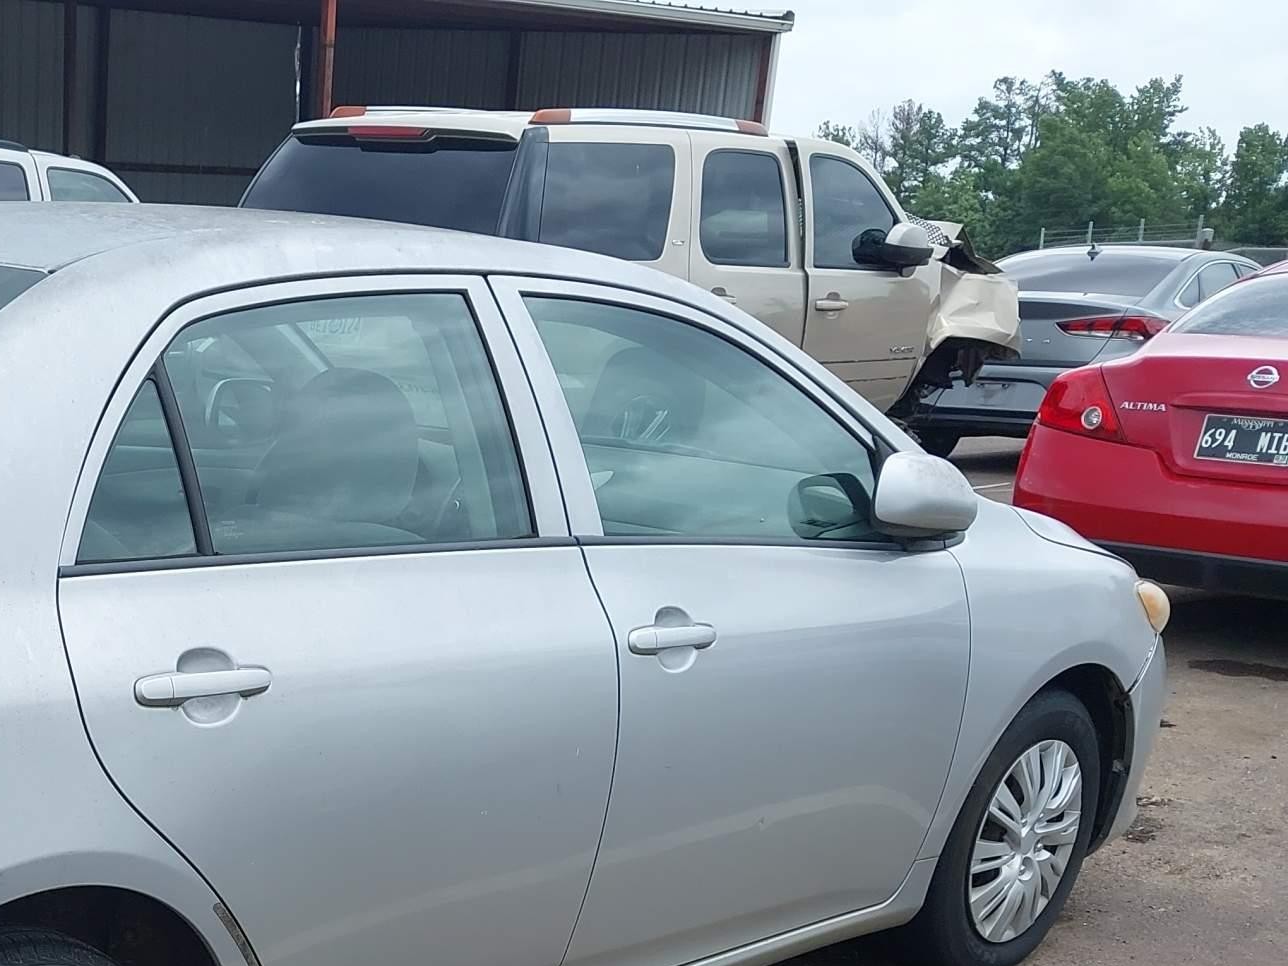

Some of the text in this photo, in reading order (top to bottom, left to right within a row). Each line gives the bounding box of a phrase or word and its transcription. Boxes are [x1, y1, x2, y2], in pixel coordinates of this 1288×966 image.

[1119, 401, 1166, 411] ALTIMA
[1201, 428, 1237, 450] 694
[1225, 452, 1259, 460] MONROE
